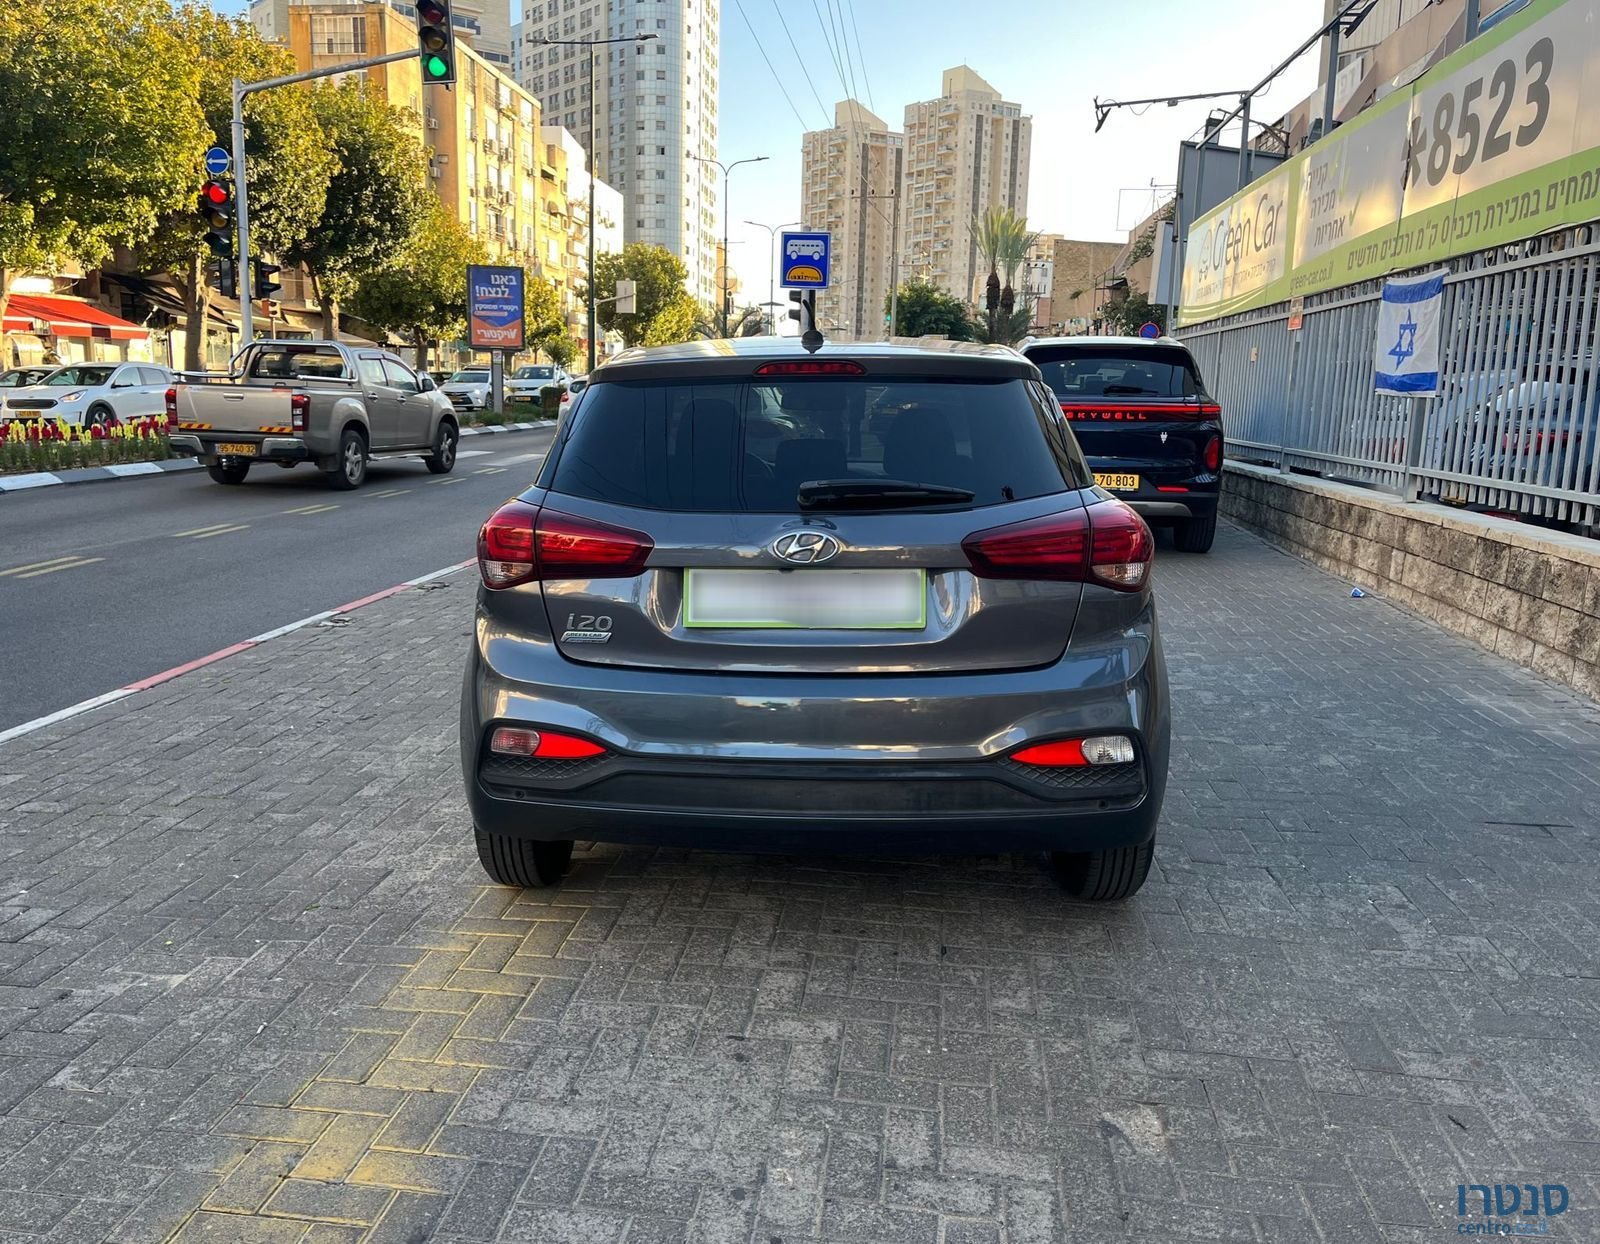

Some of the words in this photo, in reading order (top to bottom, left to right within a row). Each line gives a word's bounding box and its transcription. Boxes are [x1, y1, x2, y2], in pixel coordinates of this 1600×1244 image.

[1311, 189, 1336, 218] מכירה
[1483, 189, 1540, 231] במכירת
[1213, 216, 1251, 271] Green
[1254, 193, 1283, 252] Car
[1314, 215, 1345, 248] אחריות
[475, 285, 509, 297] לנצח!
[491, 274, 517, 285] באנו
[566, 612, 613, 631] i20
